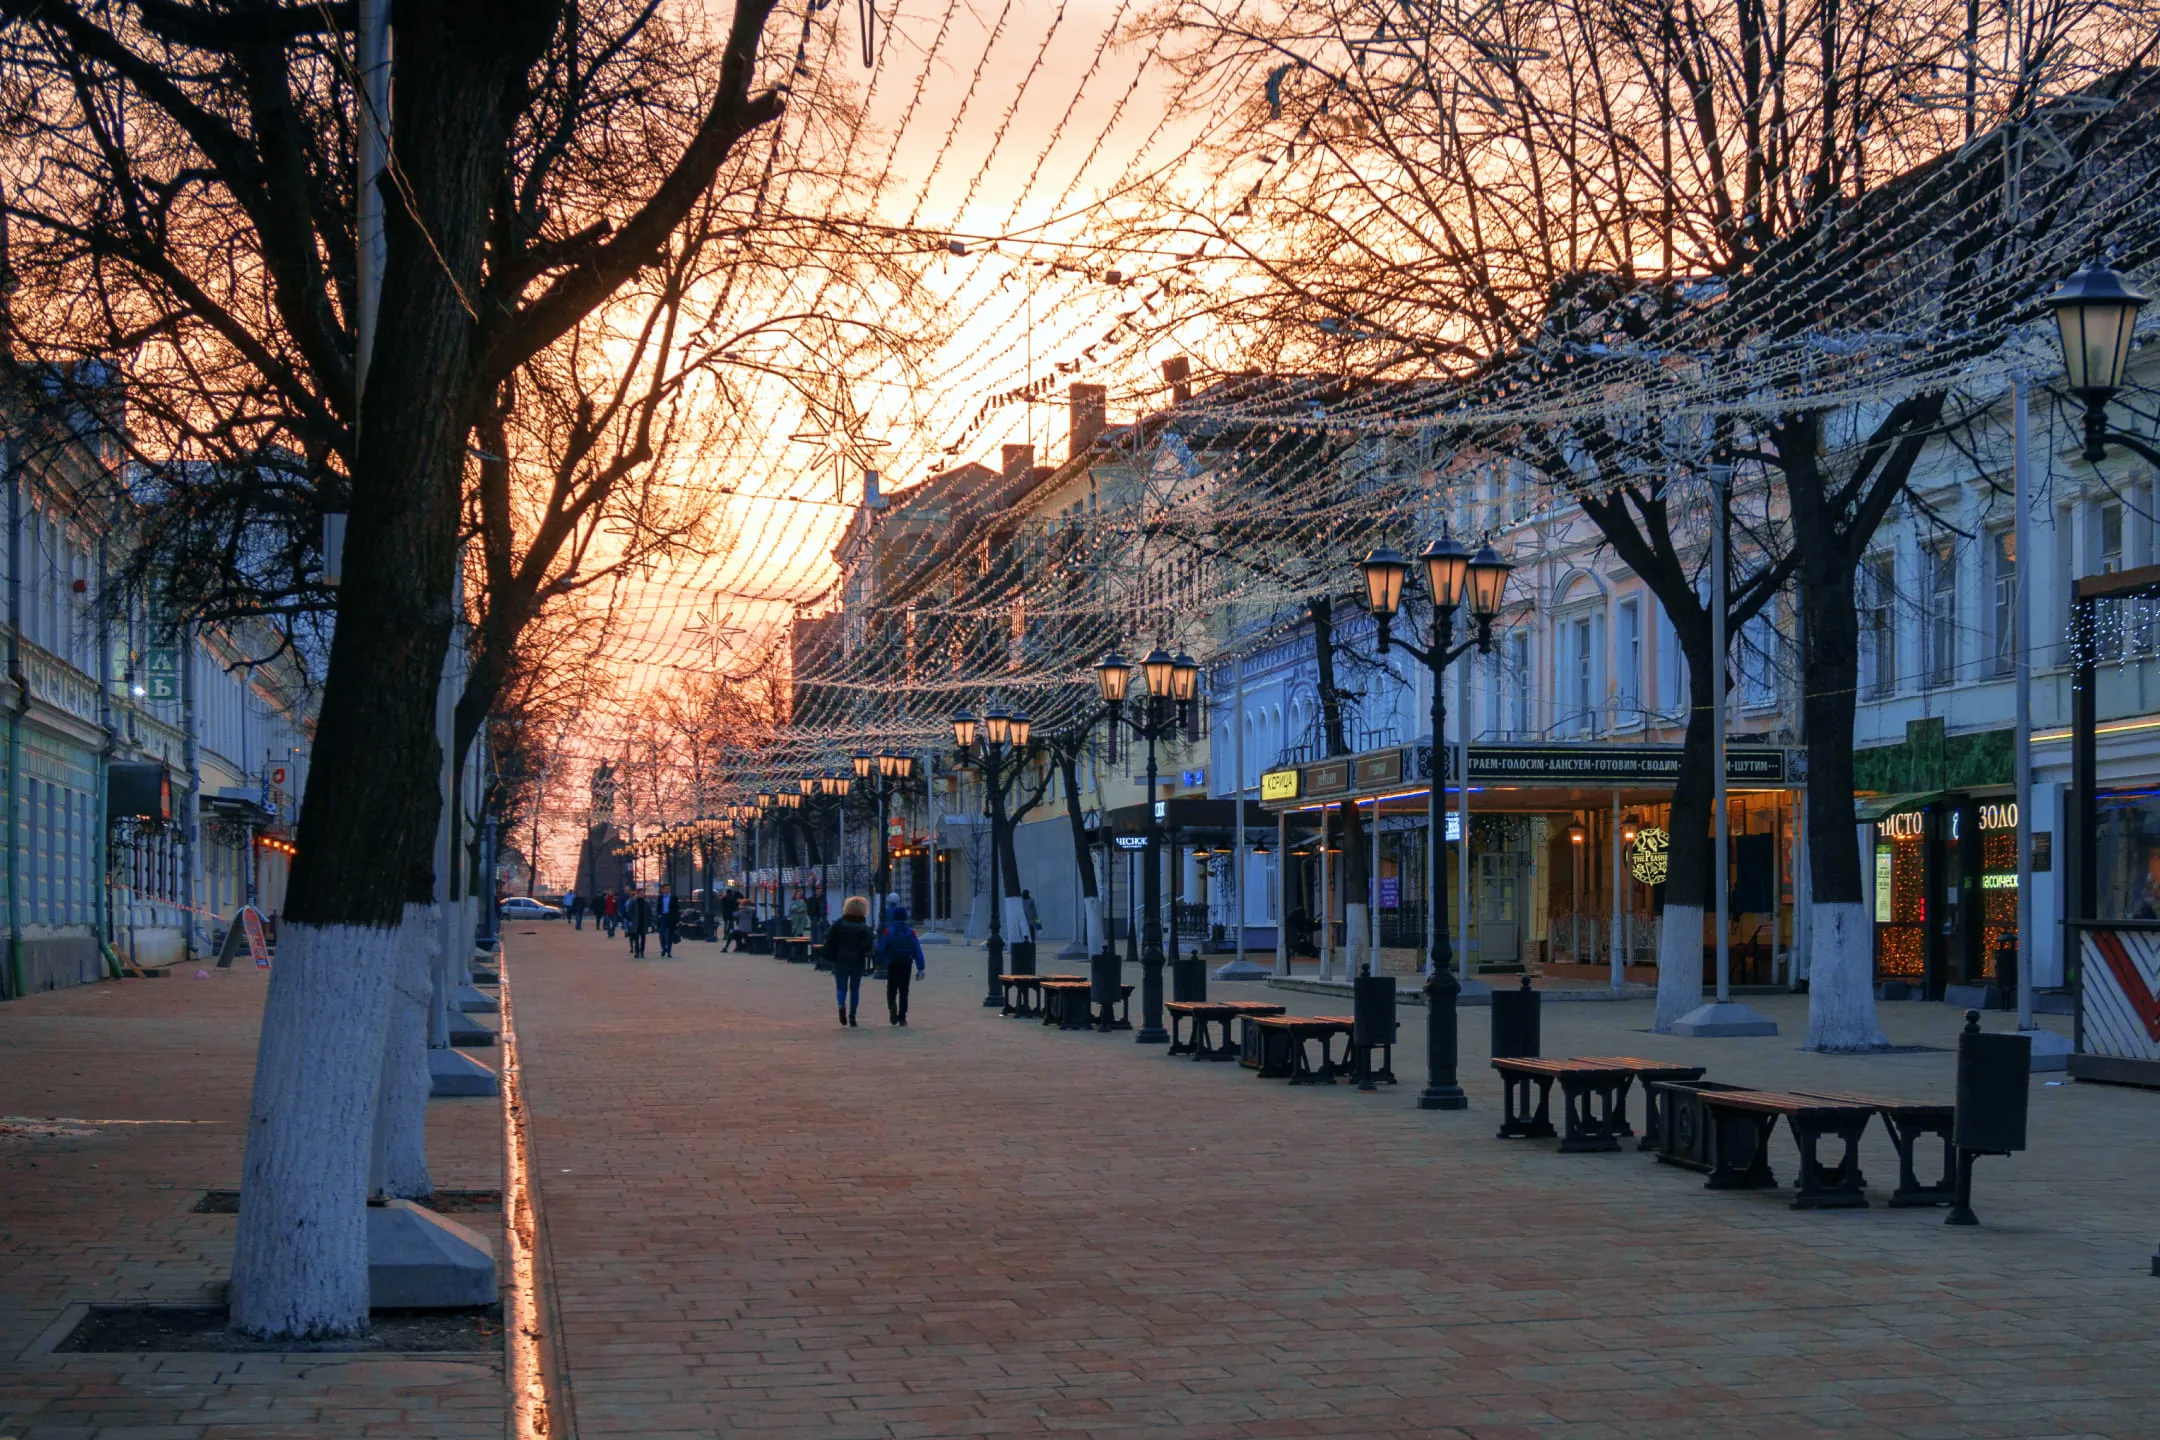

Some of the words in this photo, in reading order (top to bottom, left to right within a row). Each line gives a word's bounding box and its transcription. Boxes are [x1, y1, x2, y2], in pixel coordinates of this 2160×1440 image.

[1468, 758, 1497, 769] ГРАЕМ
[1502, 759, 1544, 770] ГОЛОСИМ
[1549, 759, 1591, 770] ДАНСУЕМ
[1595, 760, 1637, 770] ГОТОВИМ
[1641, 760, 1678, 771] СВОДИМ
[1877, 811, 1924, 836] ЧИСТО
[1979, 803, 2019, 830] ЗОЛО
